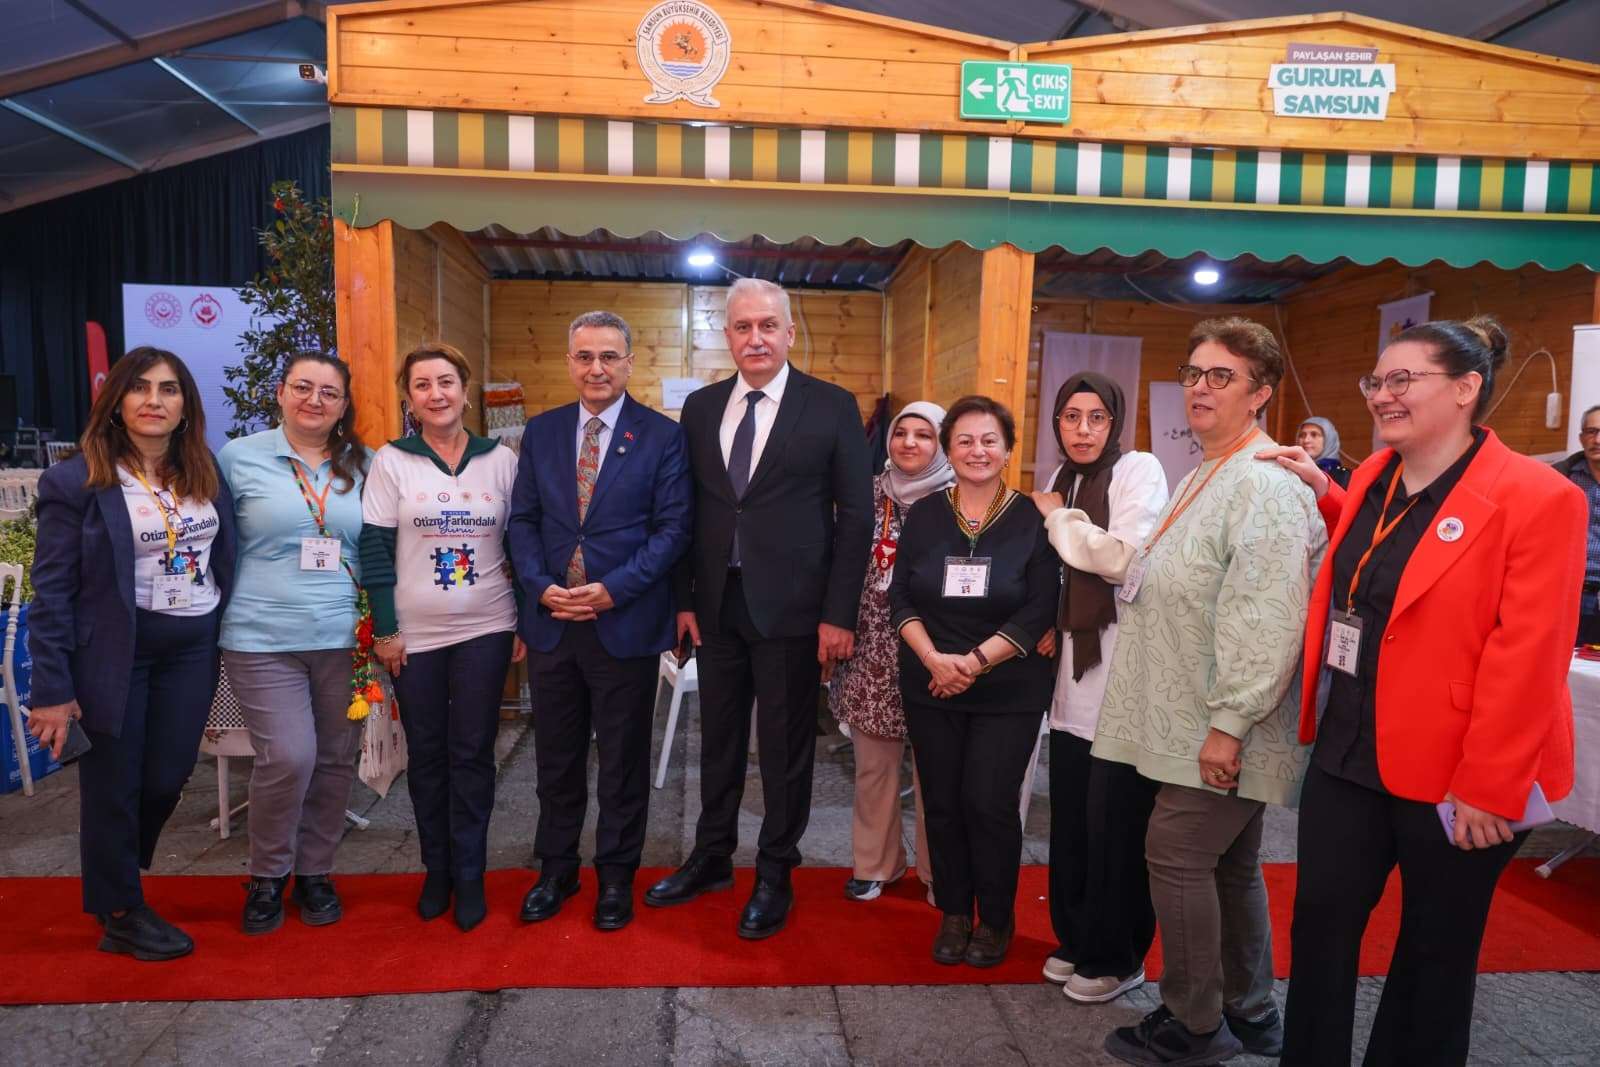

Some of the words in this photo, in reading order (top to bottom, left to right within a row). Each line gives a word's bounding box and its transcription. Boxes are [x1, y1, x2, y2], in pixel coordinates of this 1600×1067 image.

[1293, 51, 1342, 62] PAYLAŞAN
[1032, 74, 1068, 92] ÇIKIŞ
[1276, 68, 1386, 88] GURURLA
[1034, 95, 1065, 110] EXIT
[1283, 95, 1380, 114] SAMSUN
